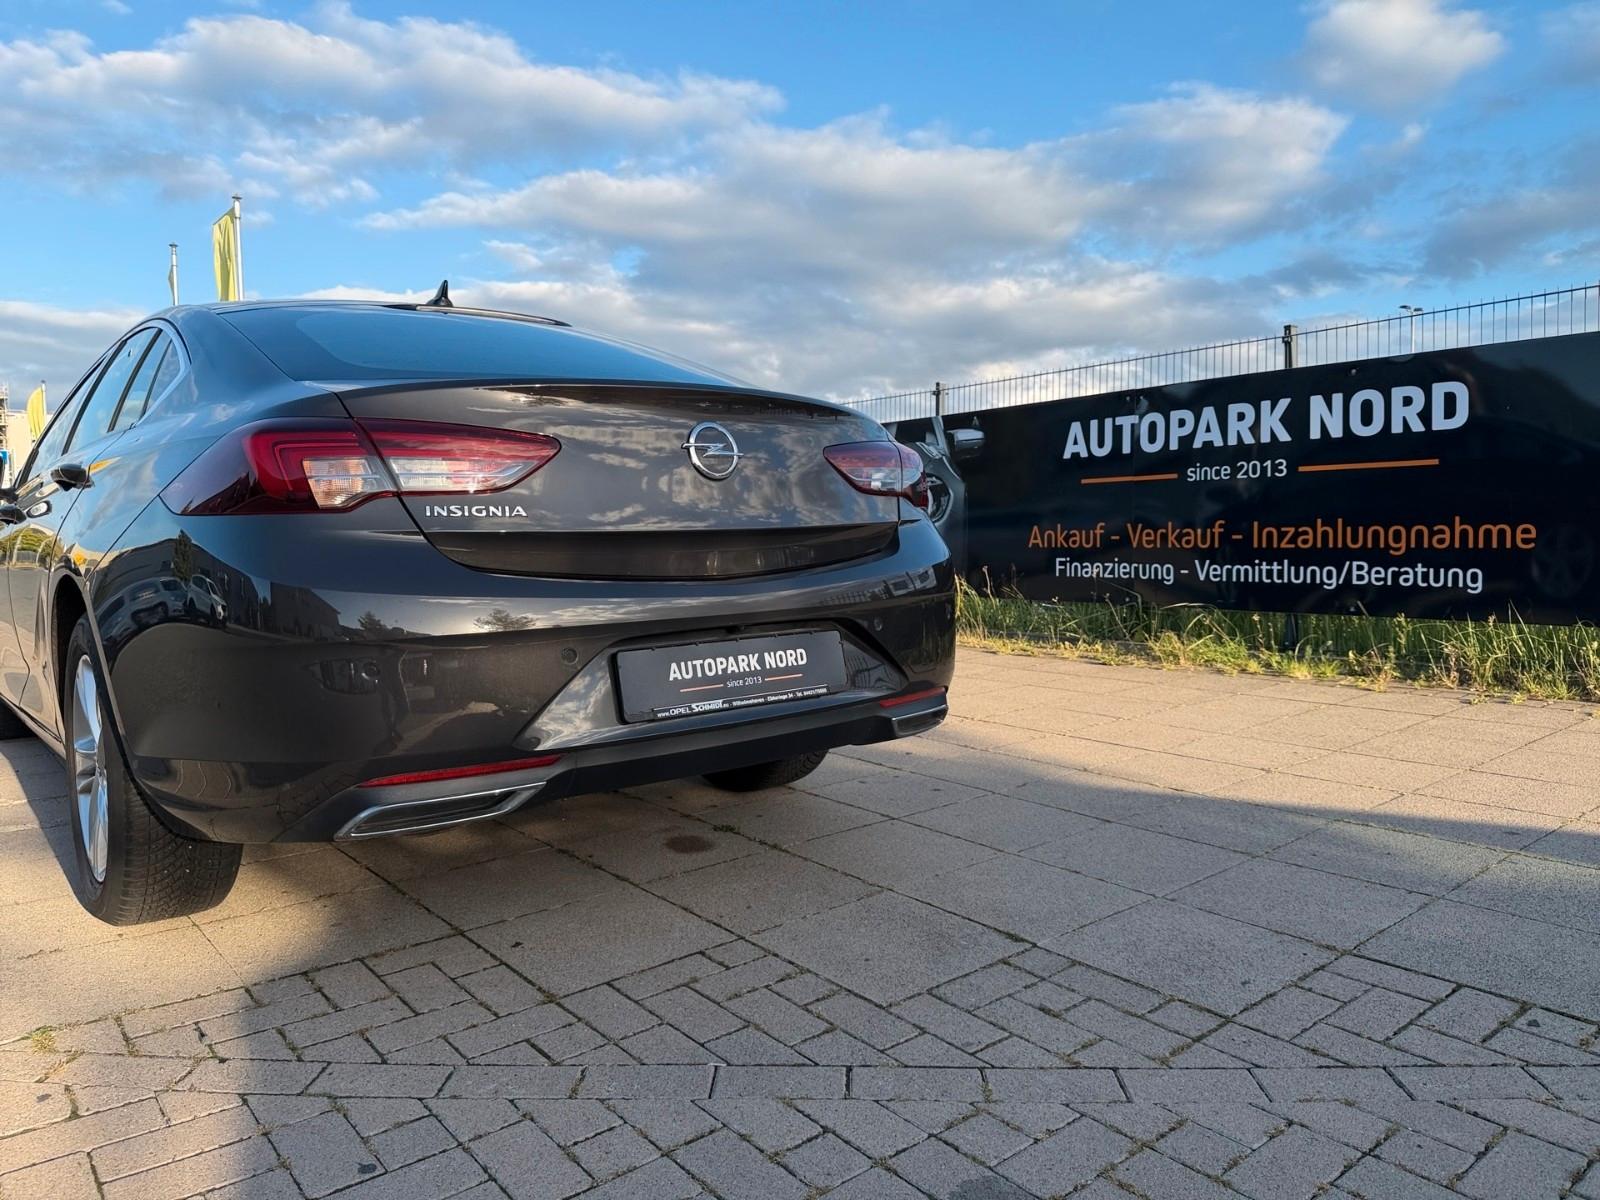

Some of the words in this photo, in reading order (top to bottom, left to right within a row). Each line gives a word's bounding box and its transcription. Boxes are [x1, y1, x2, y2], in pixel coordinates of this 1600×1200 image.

[1063, 398, 1292, 459] AUTOPARK
[1310, 381, 1470, 440] NORD
[1187, 463, 1231, 482] since
[1236, 459, 1288, 479] 2013
[425, 505, 528, 517] INSIGNIA
[1029, 522, 1105, 549] Ankauf
[1127, 520, 1225, 549] Verkauf
[1253, 516, 1537, 555] Inzahlungnahme
[1055, 557, 1174, 585] Finanzierung
[1195, 560, 1483, 594] Vermittlung/Beratung
[669, 653, 762, 681] AUTOPARK
[764, 648, 807, 669] NORD
[726, 678, 744, 688] since
[745, 676, 762, 685] 2013
